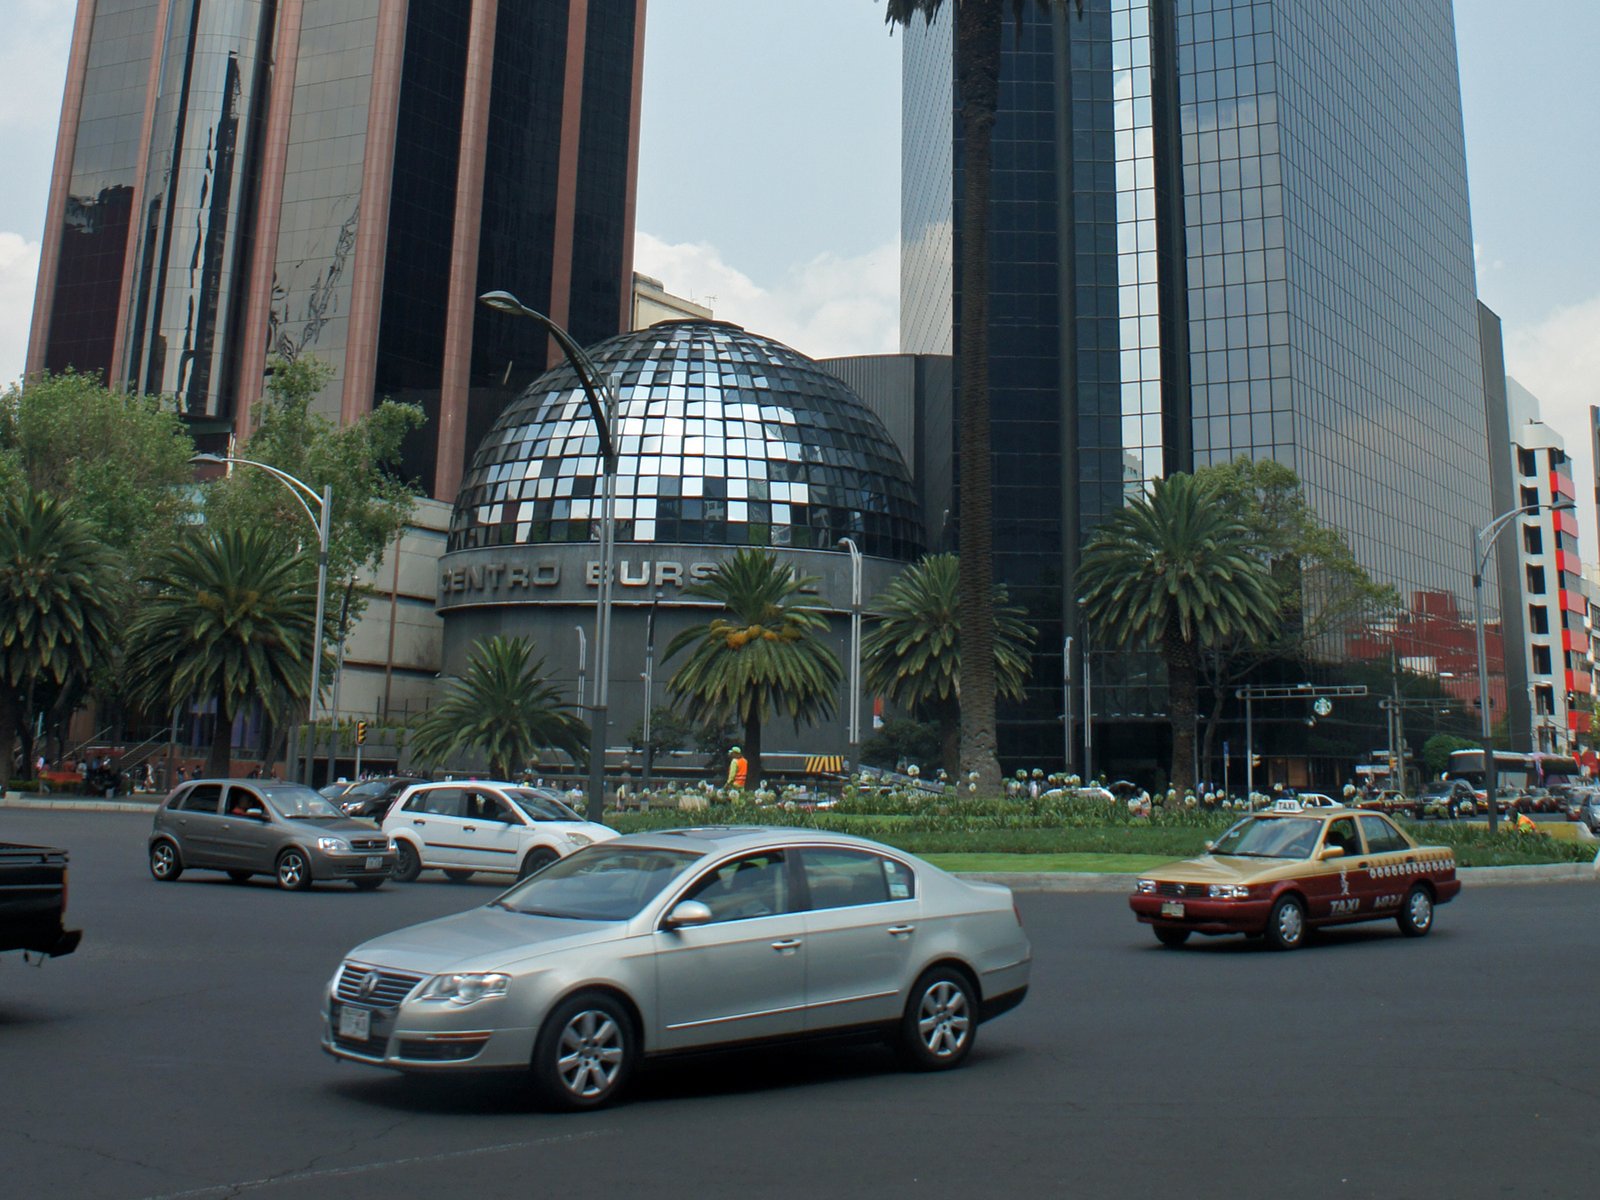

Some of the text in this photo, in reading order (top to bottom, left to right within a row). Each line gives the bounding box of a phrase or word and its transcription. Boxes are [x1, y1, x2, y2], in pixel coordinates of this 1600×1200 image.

[442, 563, 560, 591] CENTRO
[1278, 801, 1296, 810] TAXI
[1330, 898, 1360, 913] TAXI
